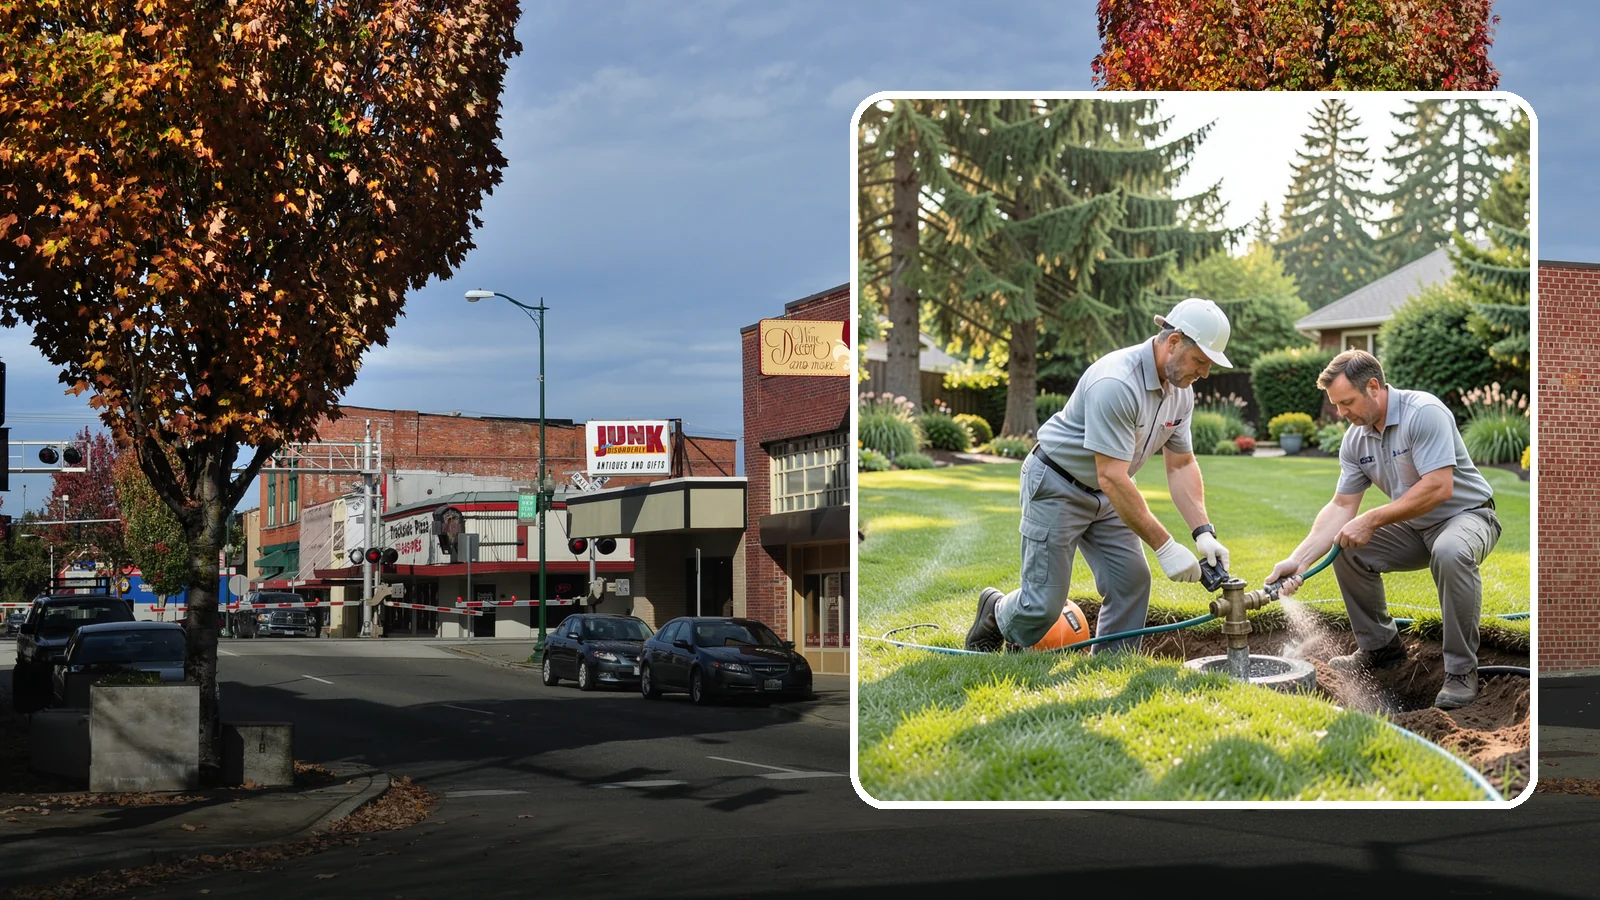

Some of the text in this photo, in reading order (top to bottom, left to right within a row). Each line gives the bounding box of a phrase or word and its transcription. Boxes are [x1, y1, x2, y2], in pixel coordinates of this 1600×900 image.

[596, 425, 665, 457] JUNK
[607, 446, 646, 454] DISORDERLY
[597, 460, 665, 470] ANTIQUES AND GIFTS
